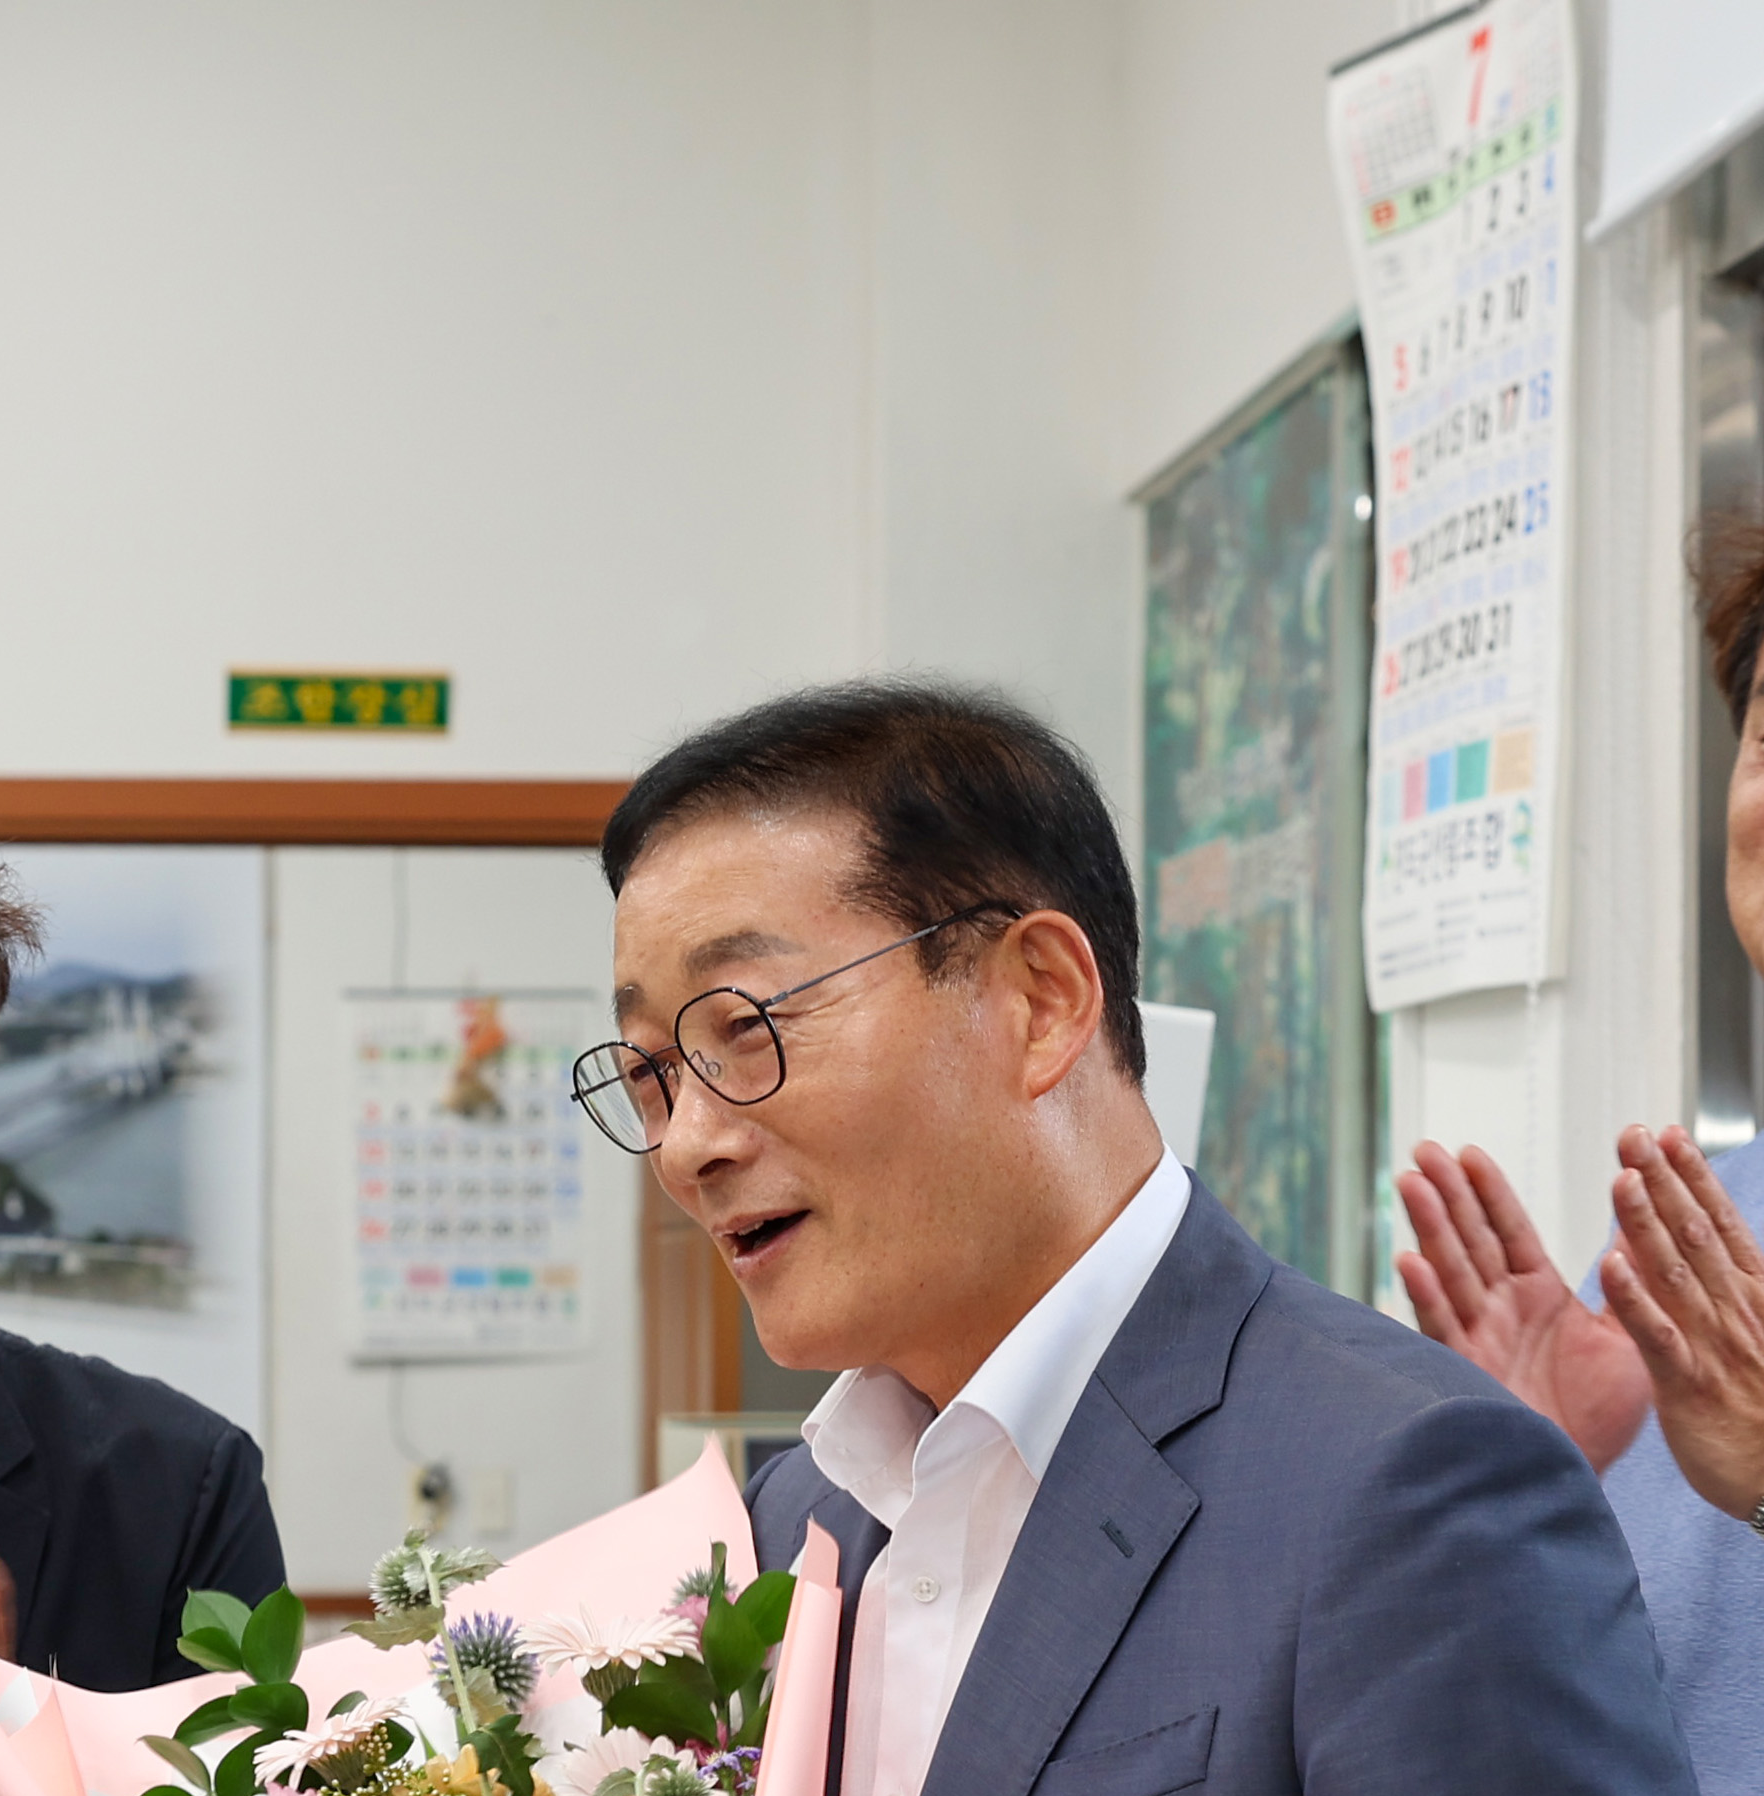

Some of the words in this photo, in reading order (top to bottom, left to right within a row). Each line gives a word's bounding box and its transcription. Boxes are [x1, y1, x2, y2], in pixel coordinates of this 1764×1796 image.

[1468, 24, 1493, 127] 7
[1488, 184, 1501, 231] 2
[1516, 168, 1530, 216] 3
